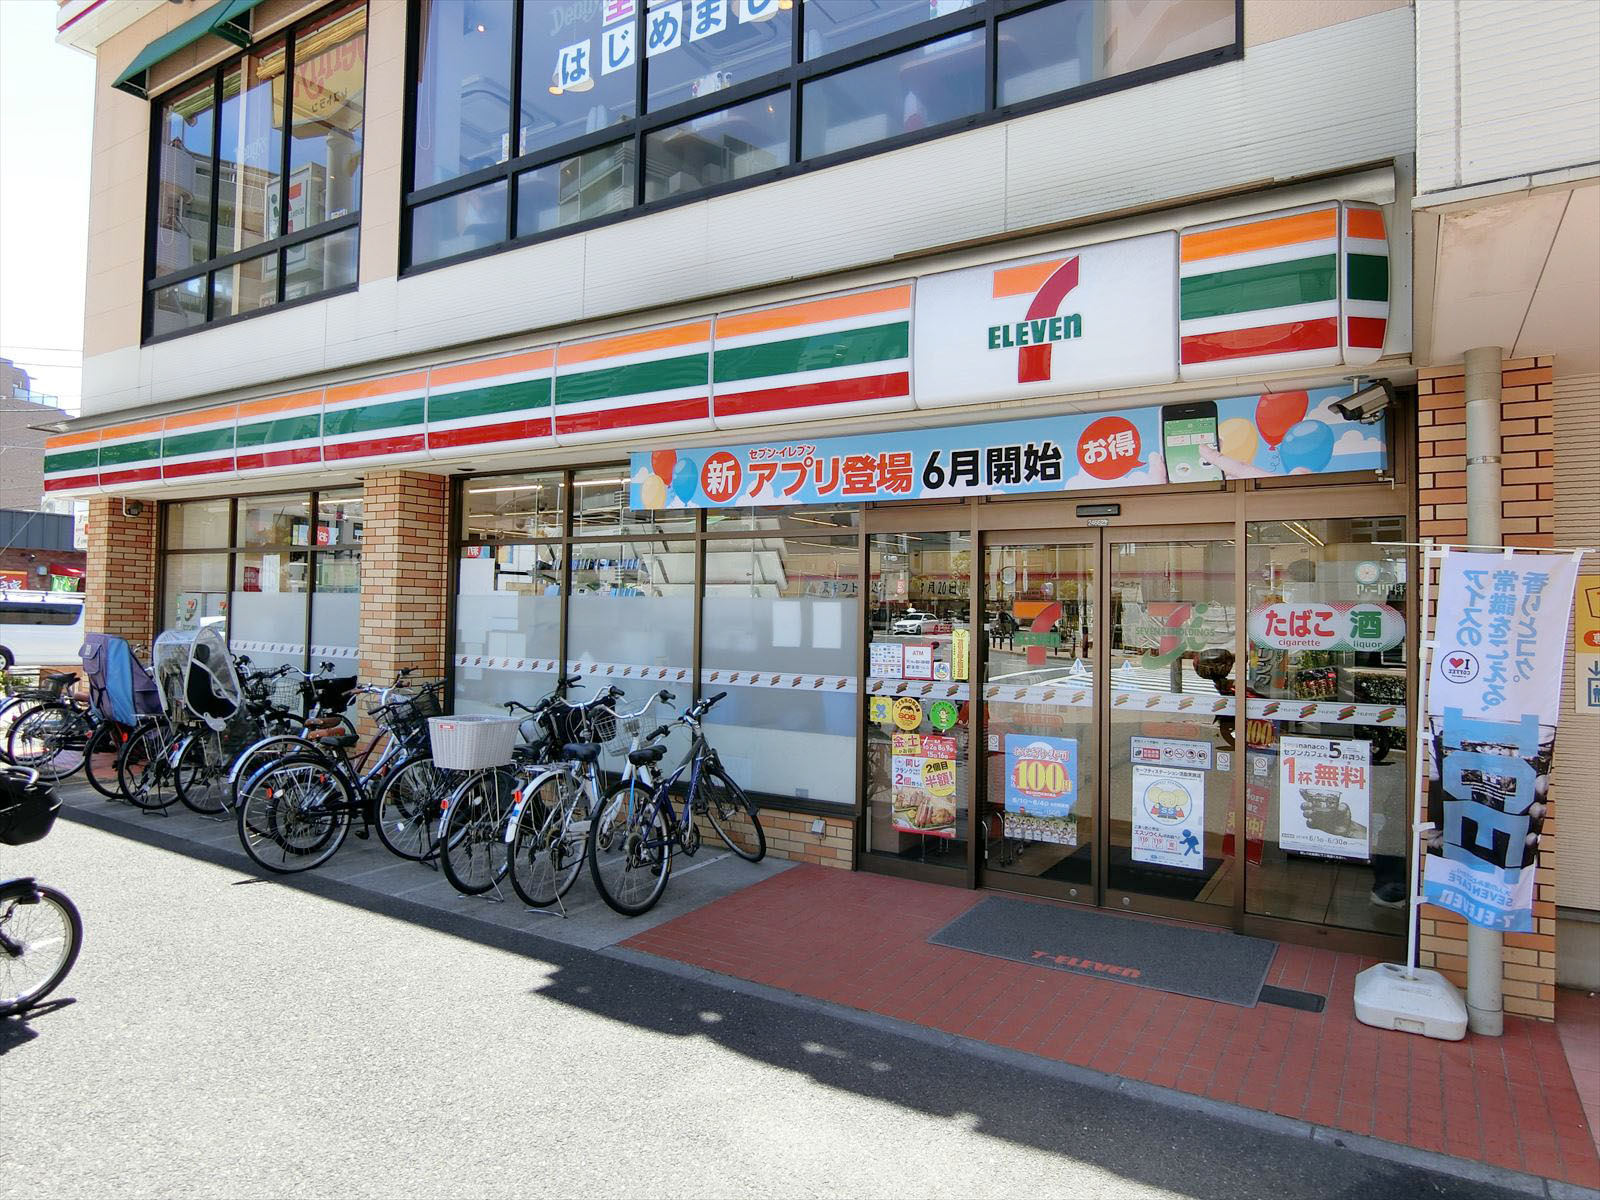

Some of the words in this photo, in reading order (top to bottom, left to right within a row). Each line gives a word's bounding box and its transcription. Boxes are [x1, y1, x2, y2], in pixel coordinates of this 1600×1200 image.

[988, 313, 1082, 349] ELEVEn
[992, 255, 1079, 384] 7
[749, 445, 816, 460] セブン・イレブン
[1083, 430, 1135, 464] お得
[706, 459, 735, 495] 新
[749, 452, 913, 498] アプリ登場
[922, 442, 1062, 490] 6月開始
[1265, 609, 1335, 638] たばこ
[1350, 610, 1382, 639] 酒
[1278, 639, 1321, 648] cigarette
[1353, 640, 1383, 649] liquor
[898, 712, 916, 721] SOS
[1329, 742, 1342, 759] 5
[1282, 757, 1367, 790] 1杯無料
